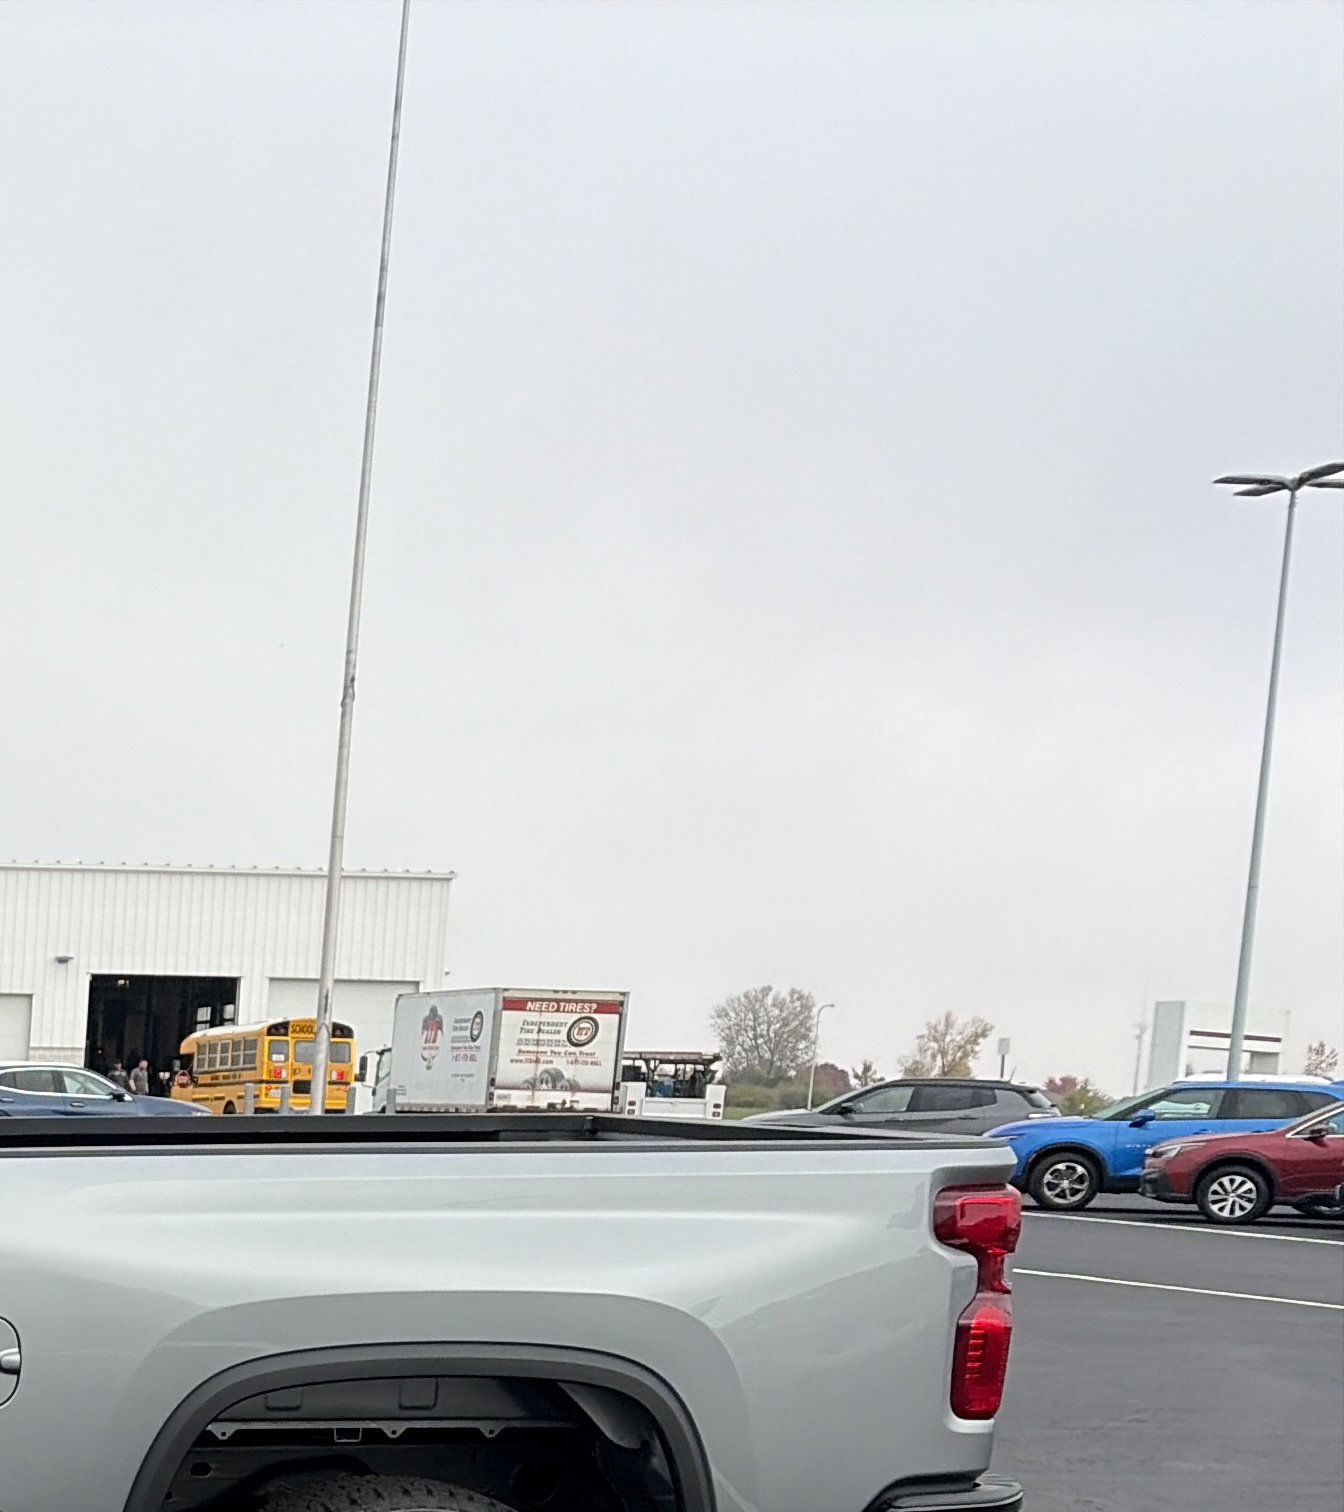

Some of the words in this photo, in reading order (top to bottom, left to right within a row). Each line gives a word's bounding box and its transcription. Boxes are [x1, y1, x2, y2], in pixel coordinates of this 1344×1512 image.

[526, 1001, 558, 1012] NEED
[560, 1002, 597, 1013] TIRES?
[290, 1023, 315, 1034] SCHOOL
